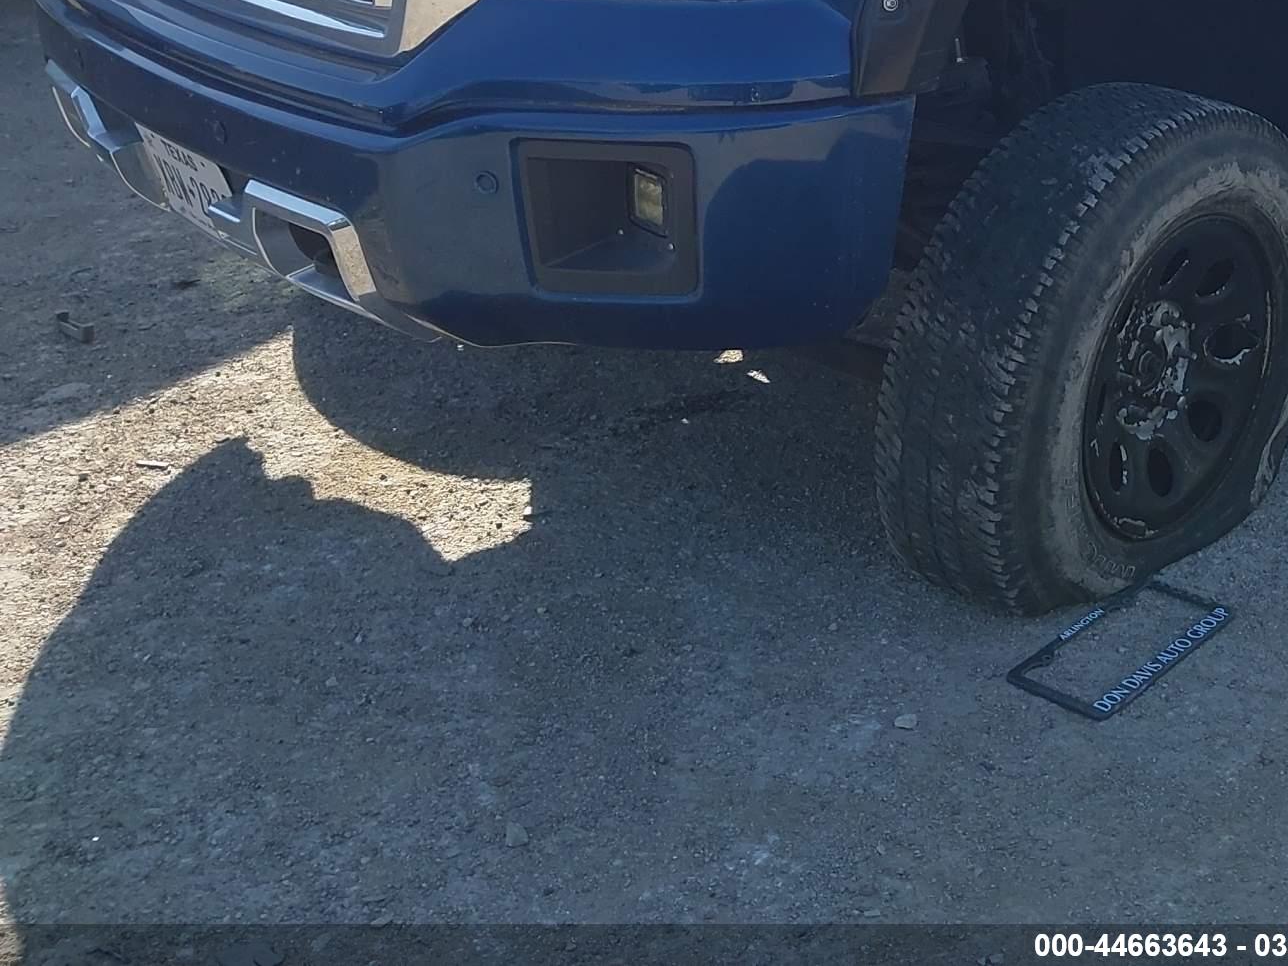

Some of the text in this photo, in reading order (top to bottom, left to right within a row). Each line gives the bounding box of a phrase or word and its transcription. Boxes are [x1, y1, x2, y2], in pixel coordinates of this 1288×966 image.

[160, 139, 198, 171] TEXAS
[1059, 608, 1105, 640] ARLINGTON
[1093, 607, 1230, 712] DON DAVIS AUTO GROUP
